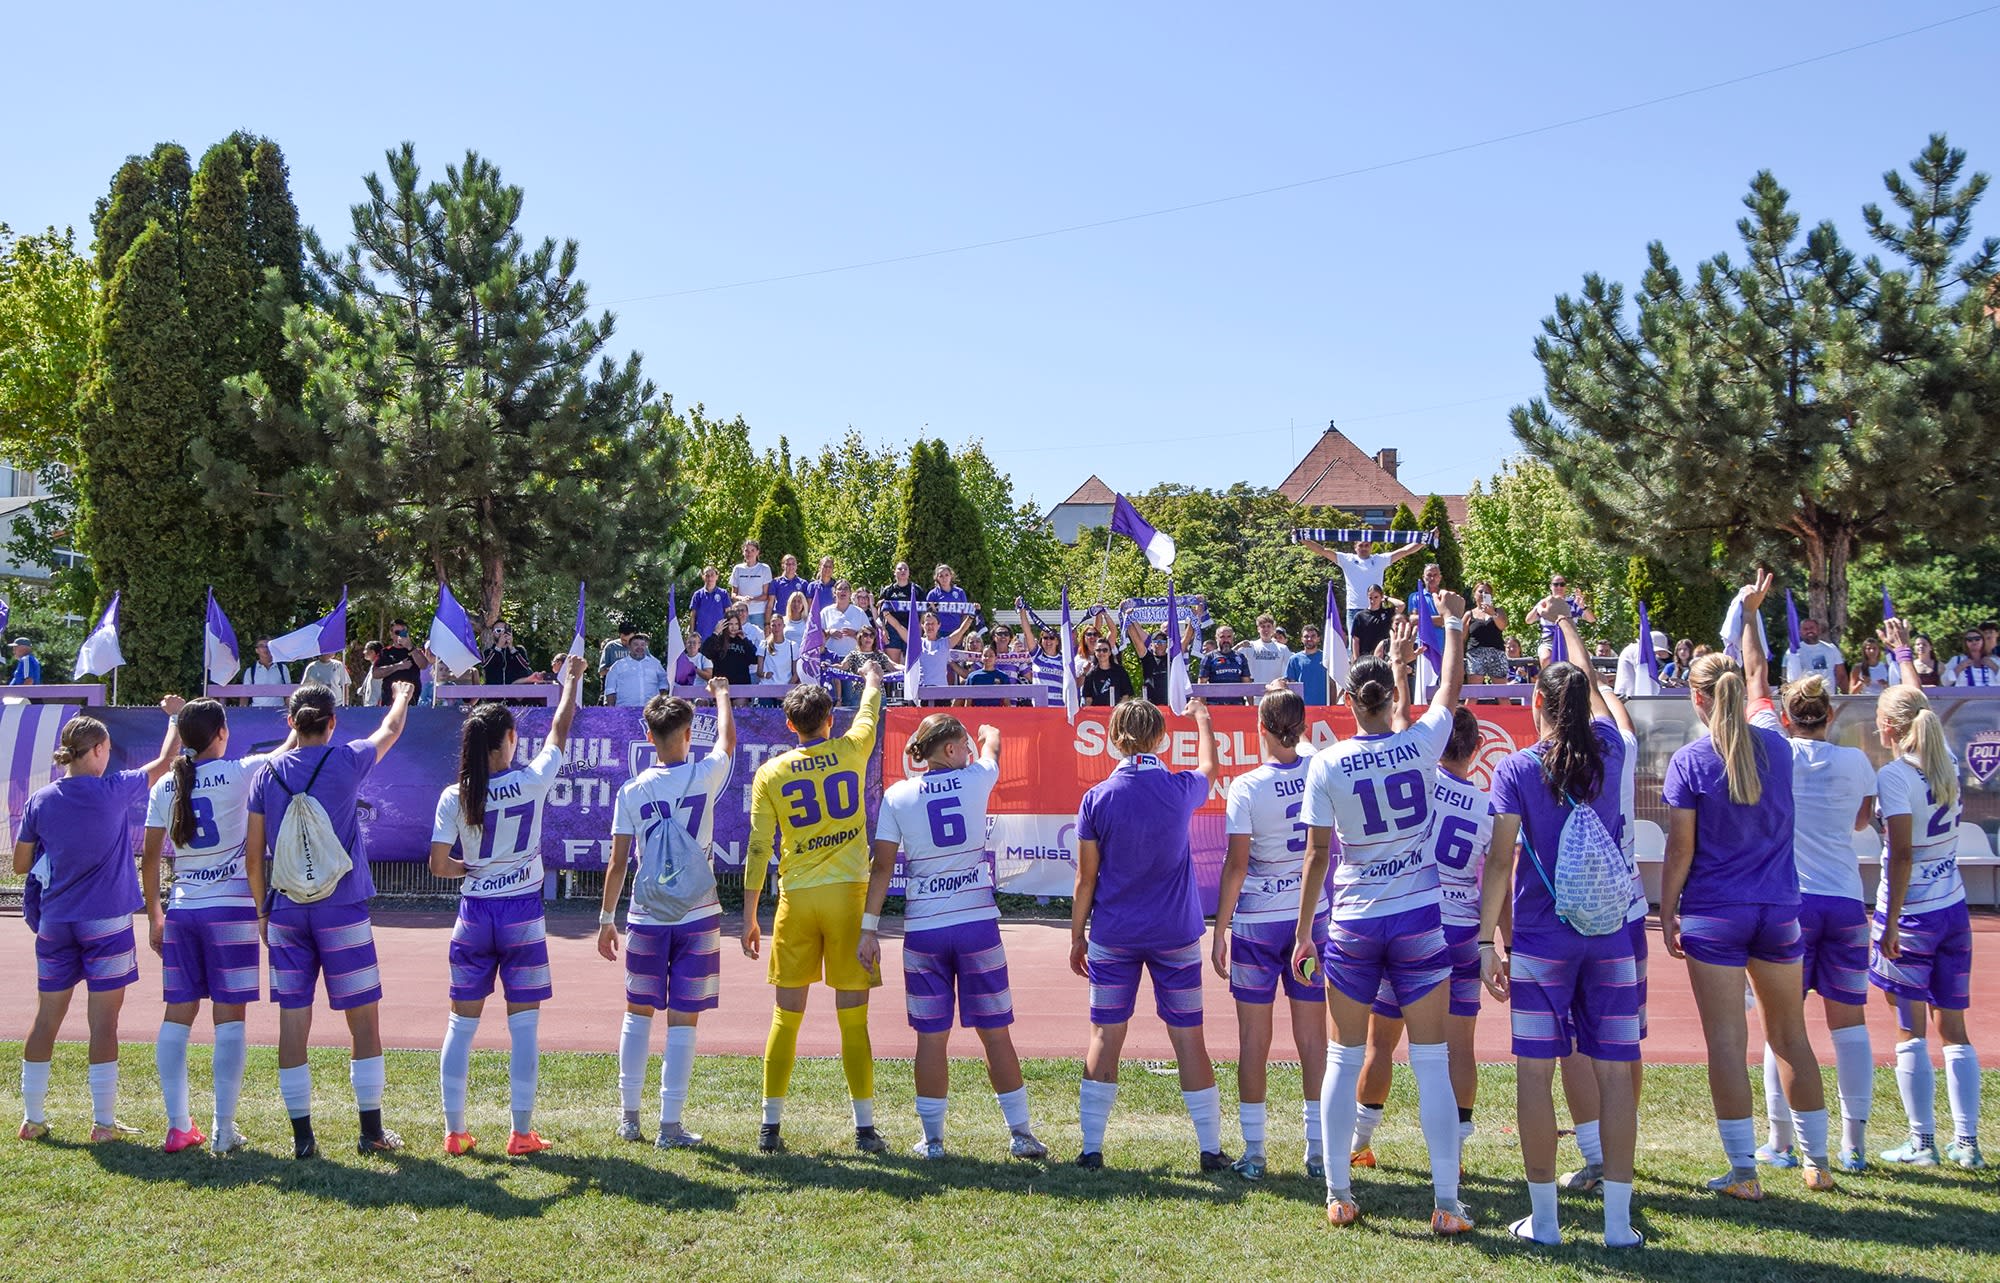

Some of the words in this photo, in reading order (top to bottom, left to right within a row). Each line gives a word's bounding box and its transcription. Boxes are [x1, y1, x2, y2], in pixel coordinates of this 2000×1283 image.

[781, 770, 859, 828] 30
[919, 777, 962, 794] NUJE
[1352, 768, 1429, 836] 19
[187, 796, 220, 849] 8
[479, 800, 535, 859] 17
[926, 796, 967, 848] 6
[1006, 846, 1071, 861] Melisa
